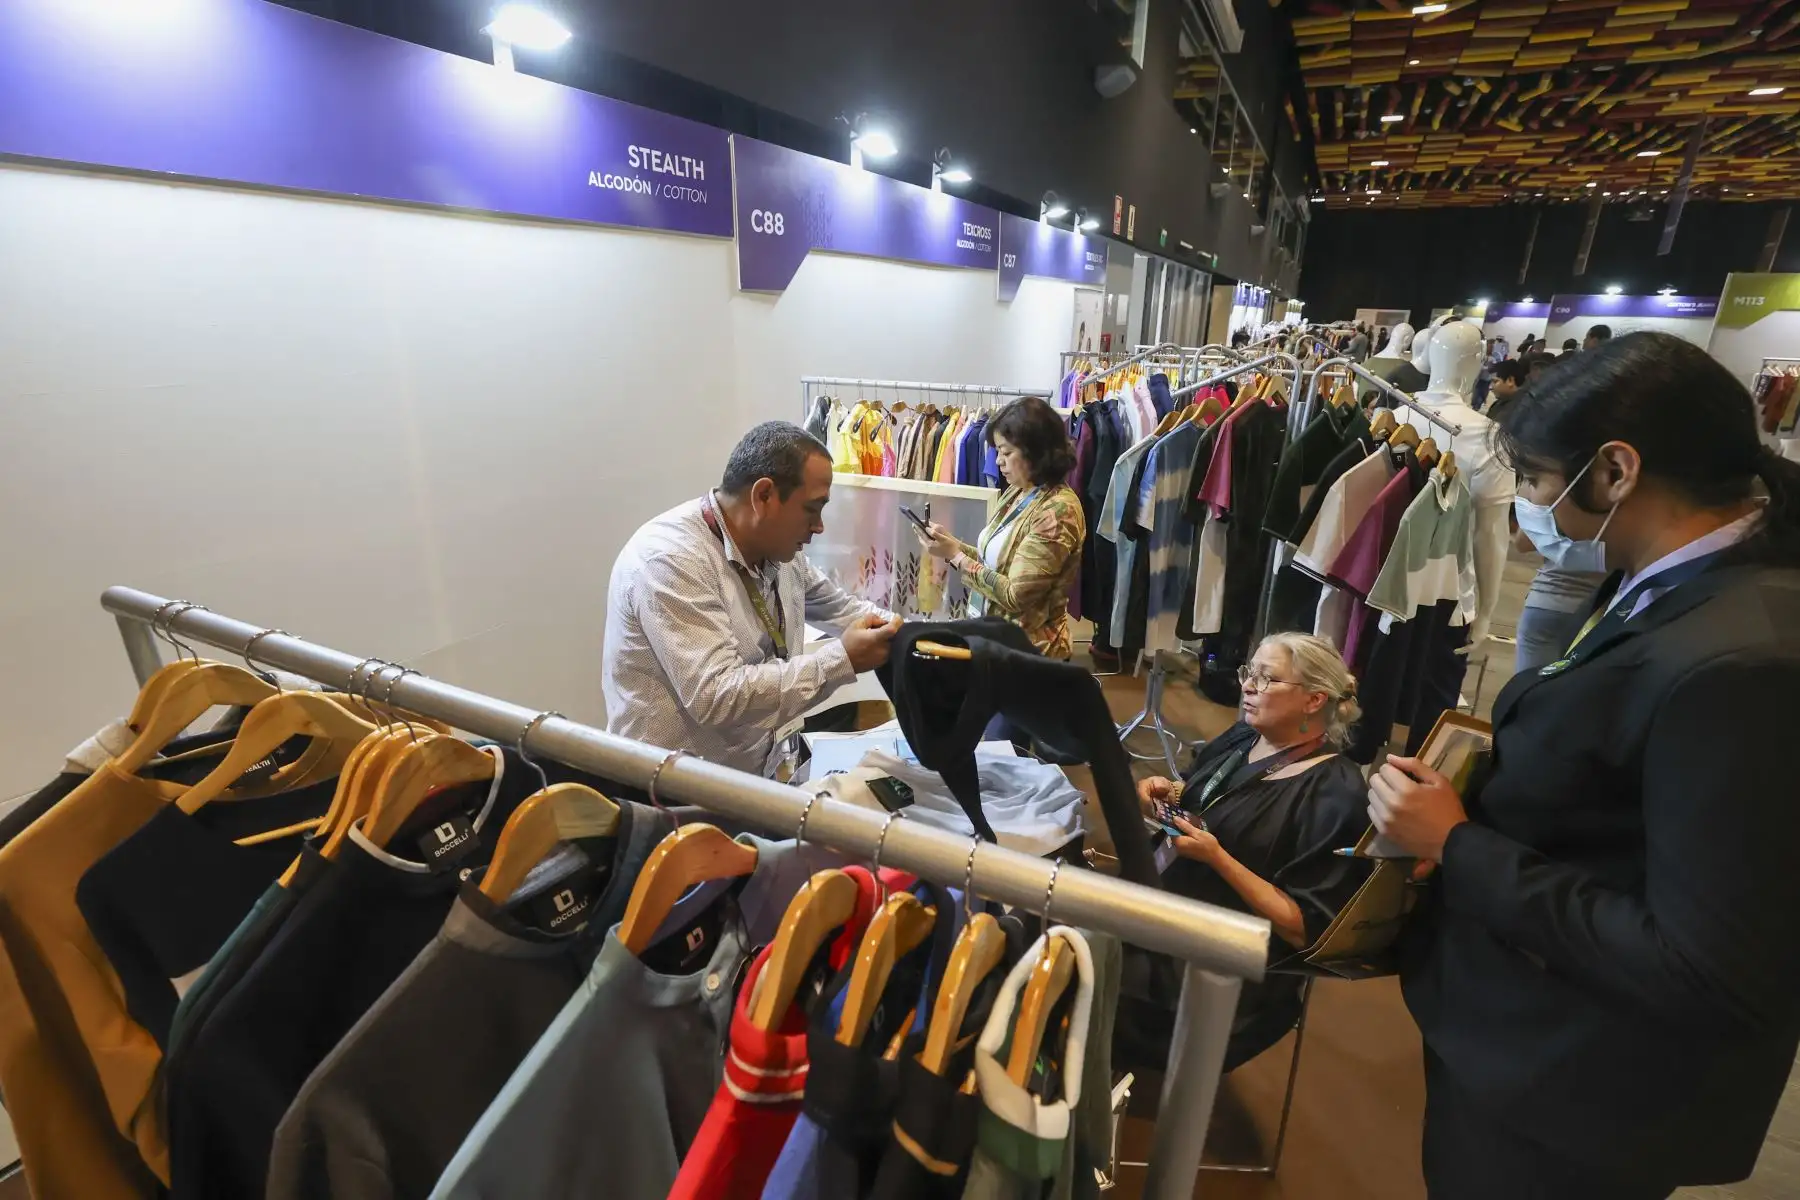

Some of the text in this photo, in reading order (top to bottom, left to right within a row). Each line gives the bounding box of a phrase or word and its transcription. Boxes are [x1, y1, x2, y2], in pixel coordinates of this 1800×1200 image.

[628, 145, 705, 180] STEALTH
[588, 171, 652, 195] ALGODÓN
[663, 185, 708, 204] COTTON
[750, 209, 785, 236] C88
[963, 222, 992, 240] TEXCROSS
[1003, 253, 1016, 268] C87
[1733, 296, 1766, 307] M113
[434, 832, 469, 858] BOCCELLI
[550, 899, 589, 928] BOCCELLI
